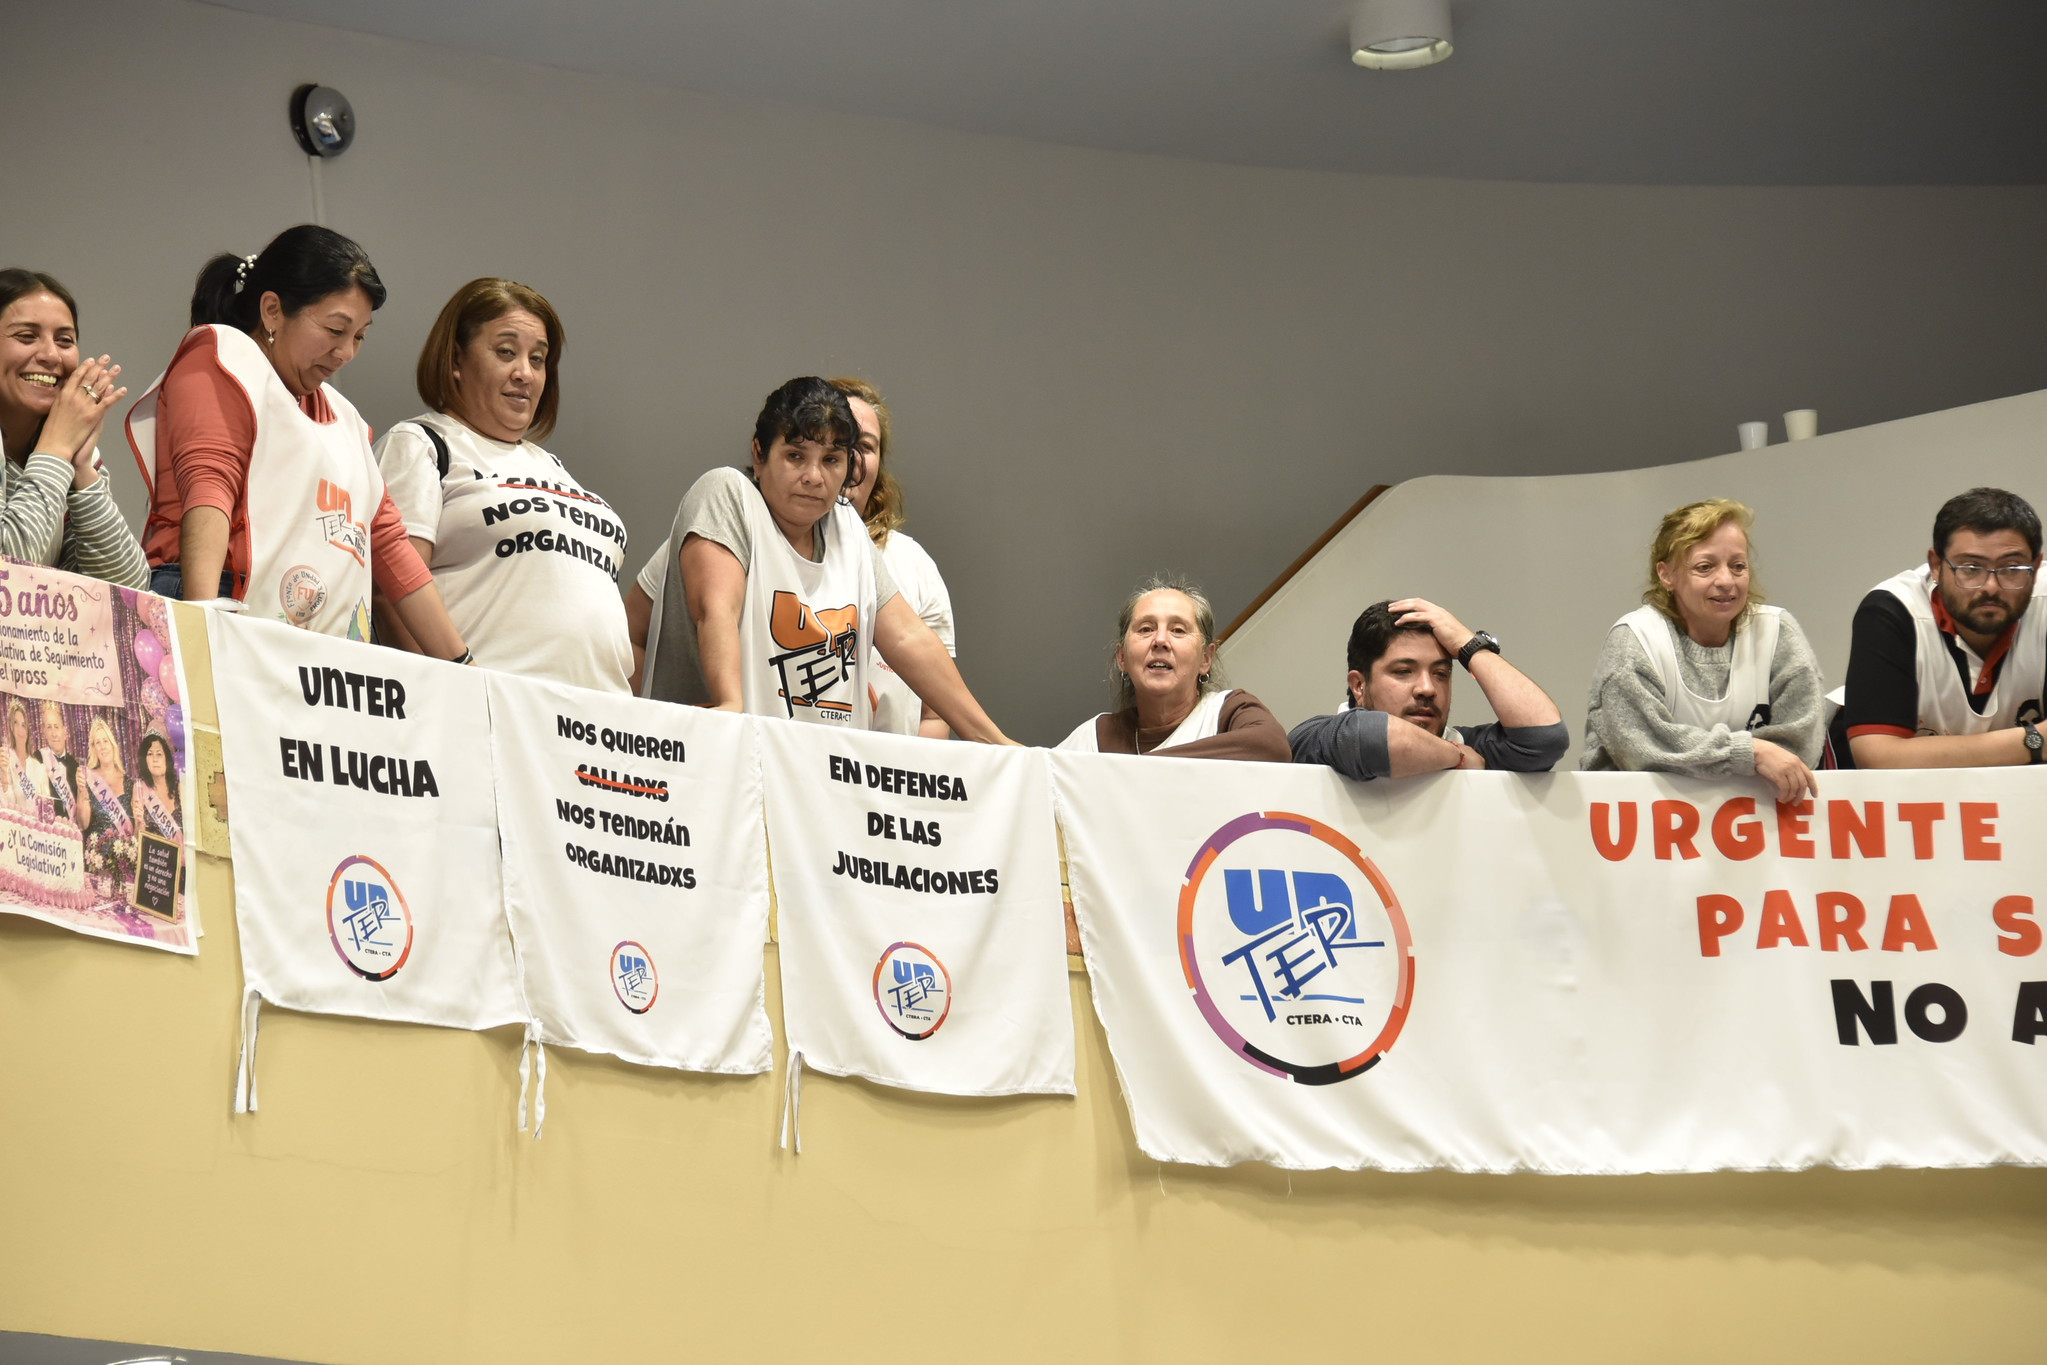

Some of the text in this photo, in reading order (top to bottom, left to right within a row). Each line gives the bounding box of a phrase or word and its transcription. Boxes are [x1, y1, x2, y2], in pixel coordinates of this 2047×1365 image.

[482, 497, 550, 526] NOS
[18, 584, 78, 621] años
[53, 626, 65, 645] de
[68, 628, 78, 646] la
[30, 645, 42, 662] de
[45, 646, 104, 670] Seguimiento
[10, 664, 48, 689] ipross
[556, 714, 597, 746] NOS
[820, 711, 842, 721] CTERA
[279, 736, 440, 798] EN LUCHA
[576, 763, 670, 803] CALLADXS
[829, 754, 968, 801] EN DEFENSA
[99, 789, 126, 826] AJSRN
[152, 804, 177, 839] AJSRN
[556, 798, 596, 830] NOS
[8, 829, 67, 860] ¿Y la Comisión
[867, 811, 942, 847] DE LAS
[1589, 796, 2003, 862] URGENTE
[16, 848, 67, 878] Legislativa?
[832, 850, 999, 895] JUBILACIONES
[1696, 889, 2044, 958] PARA S
[1221, 906, 1386, 1023] TER
[1286, 1014, 1363, 1027] CTERA CTA
[1830, 979, 1969, 1046] NO
